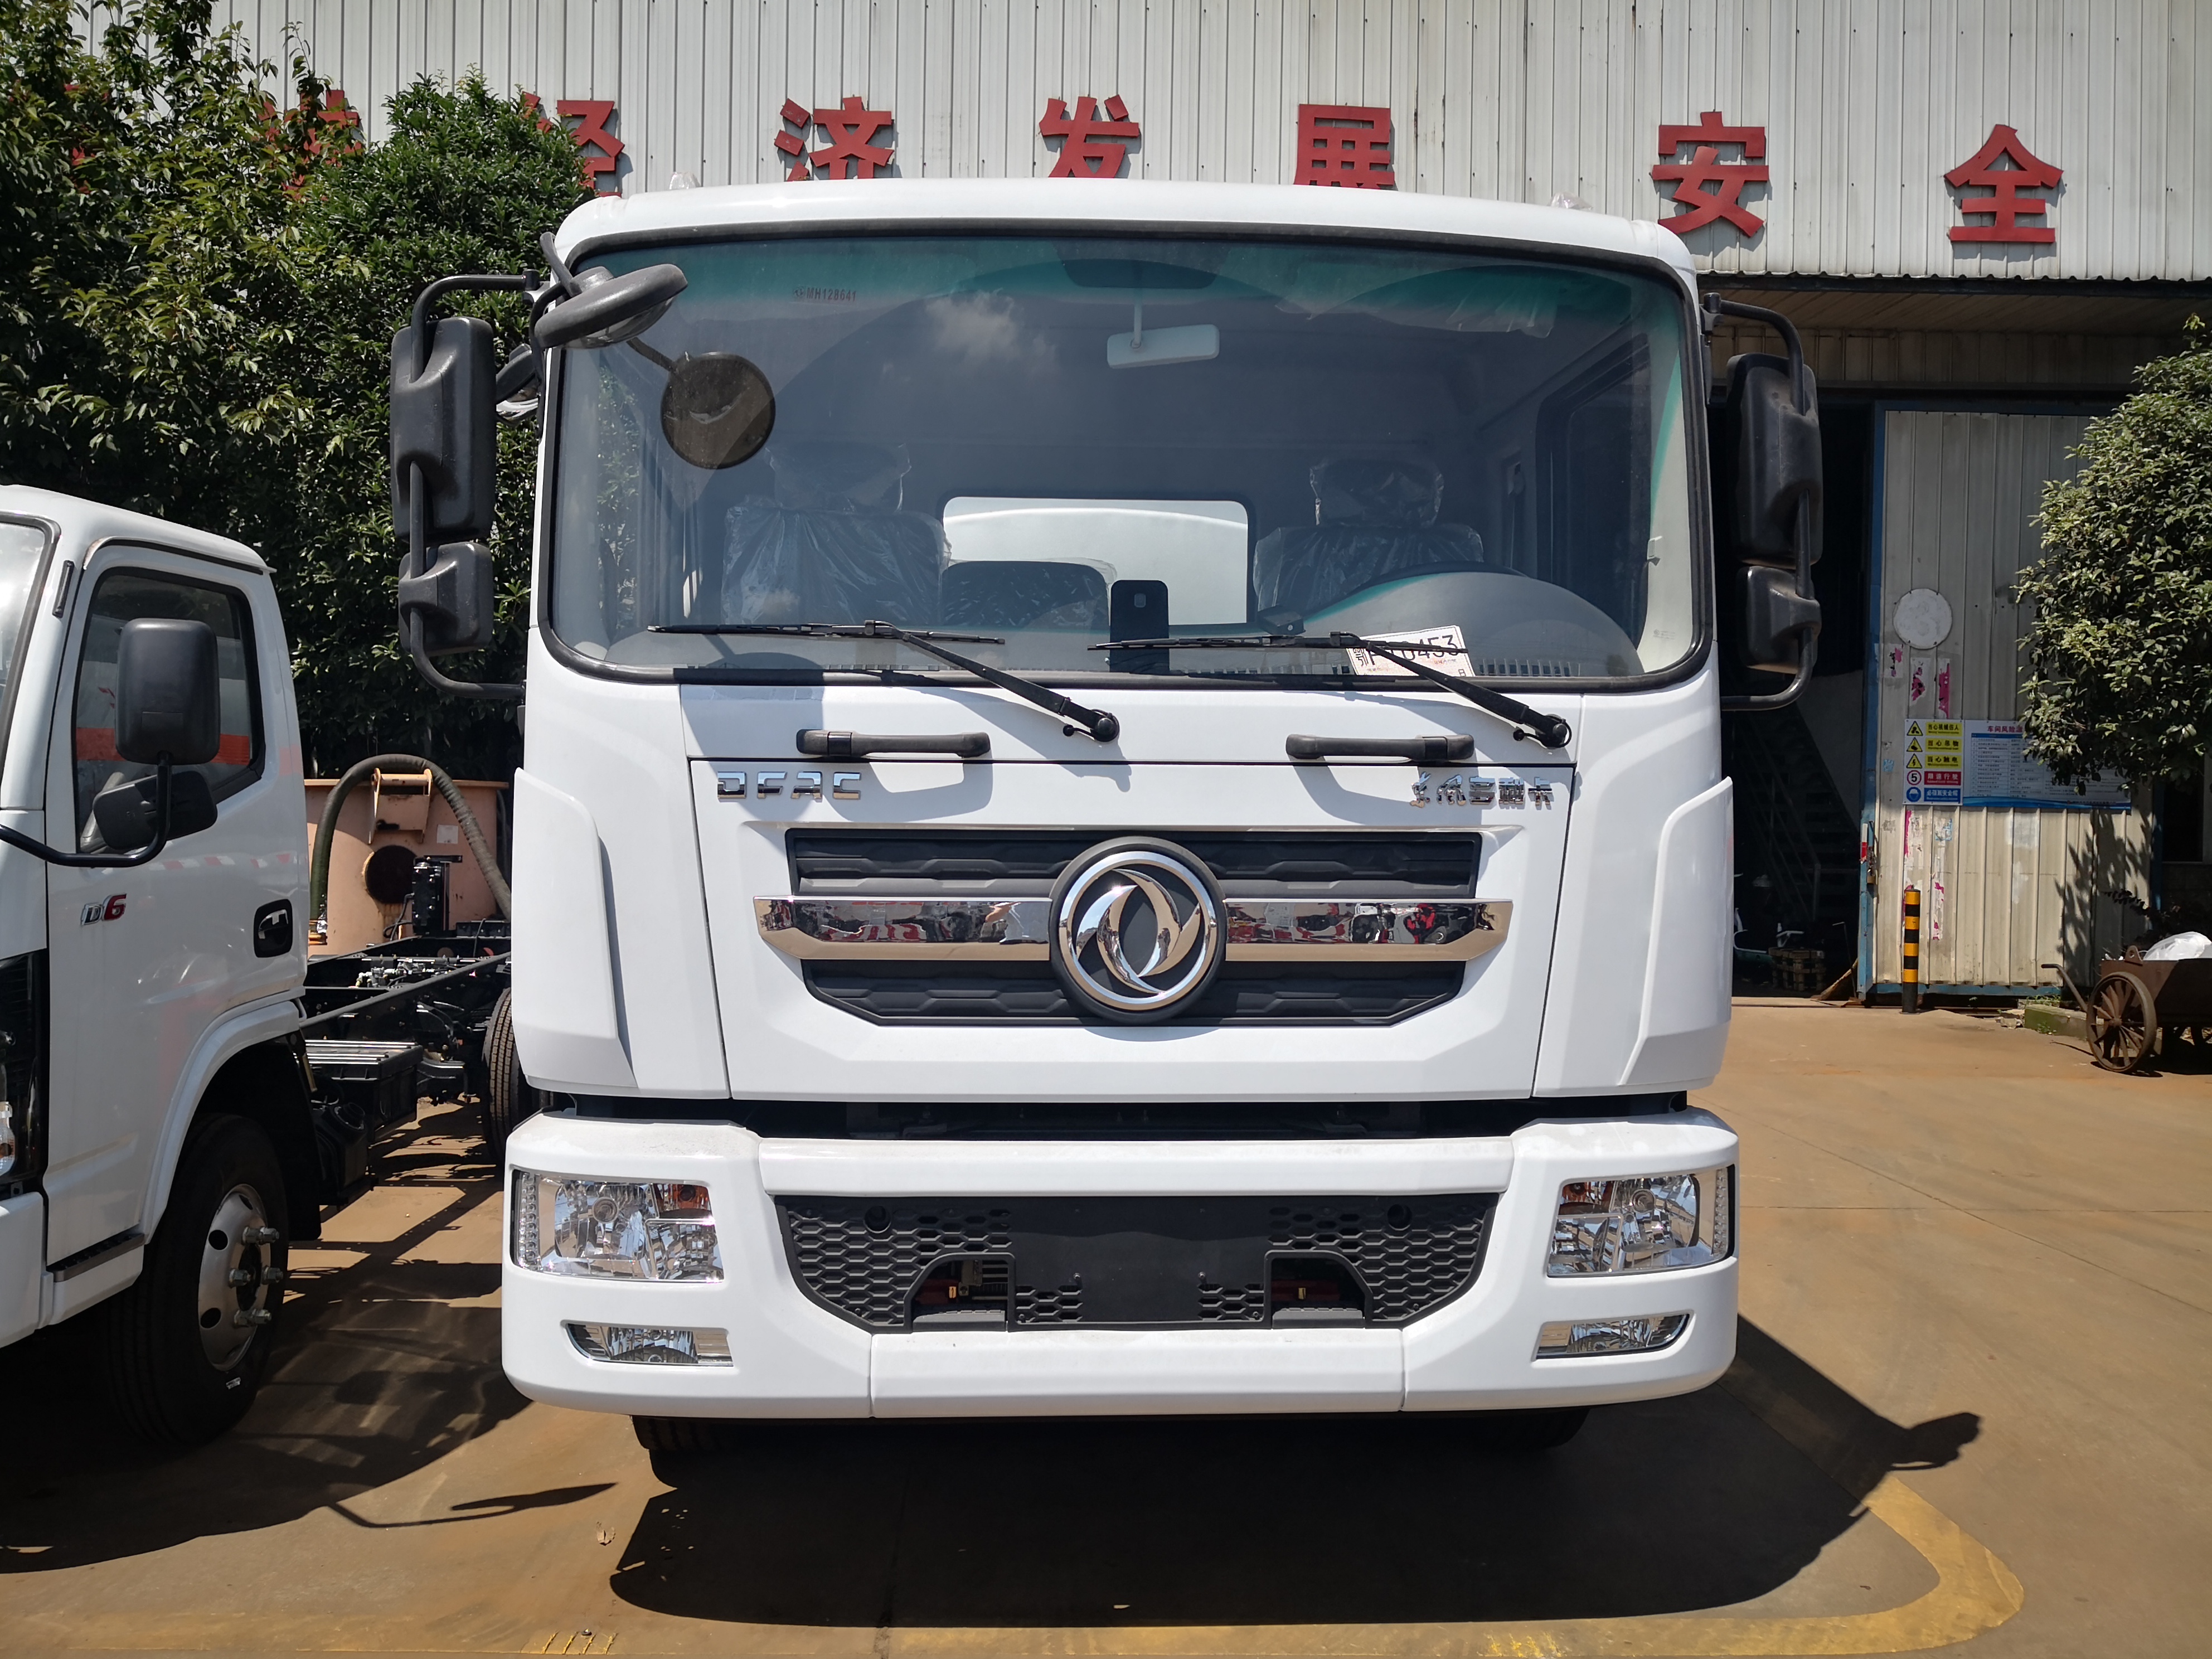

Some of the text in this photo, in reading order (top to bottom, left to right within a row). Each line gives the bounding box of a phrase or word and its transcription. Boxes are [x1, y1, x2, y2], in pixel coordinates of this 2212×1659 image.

[1651, 111, 2064, 244] 安全
[717, 771, 862, 800] DFAC
[1911, 773, 1918, 783] 5
[80, 893, 127, 926] D6
